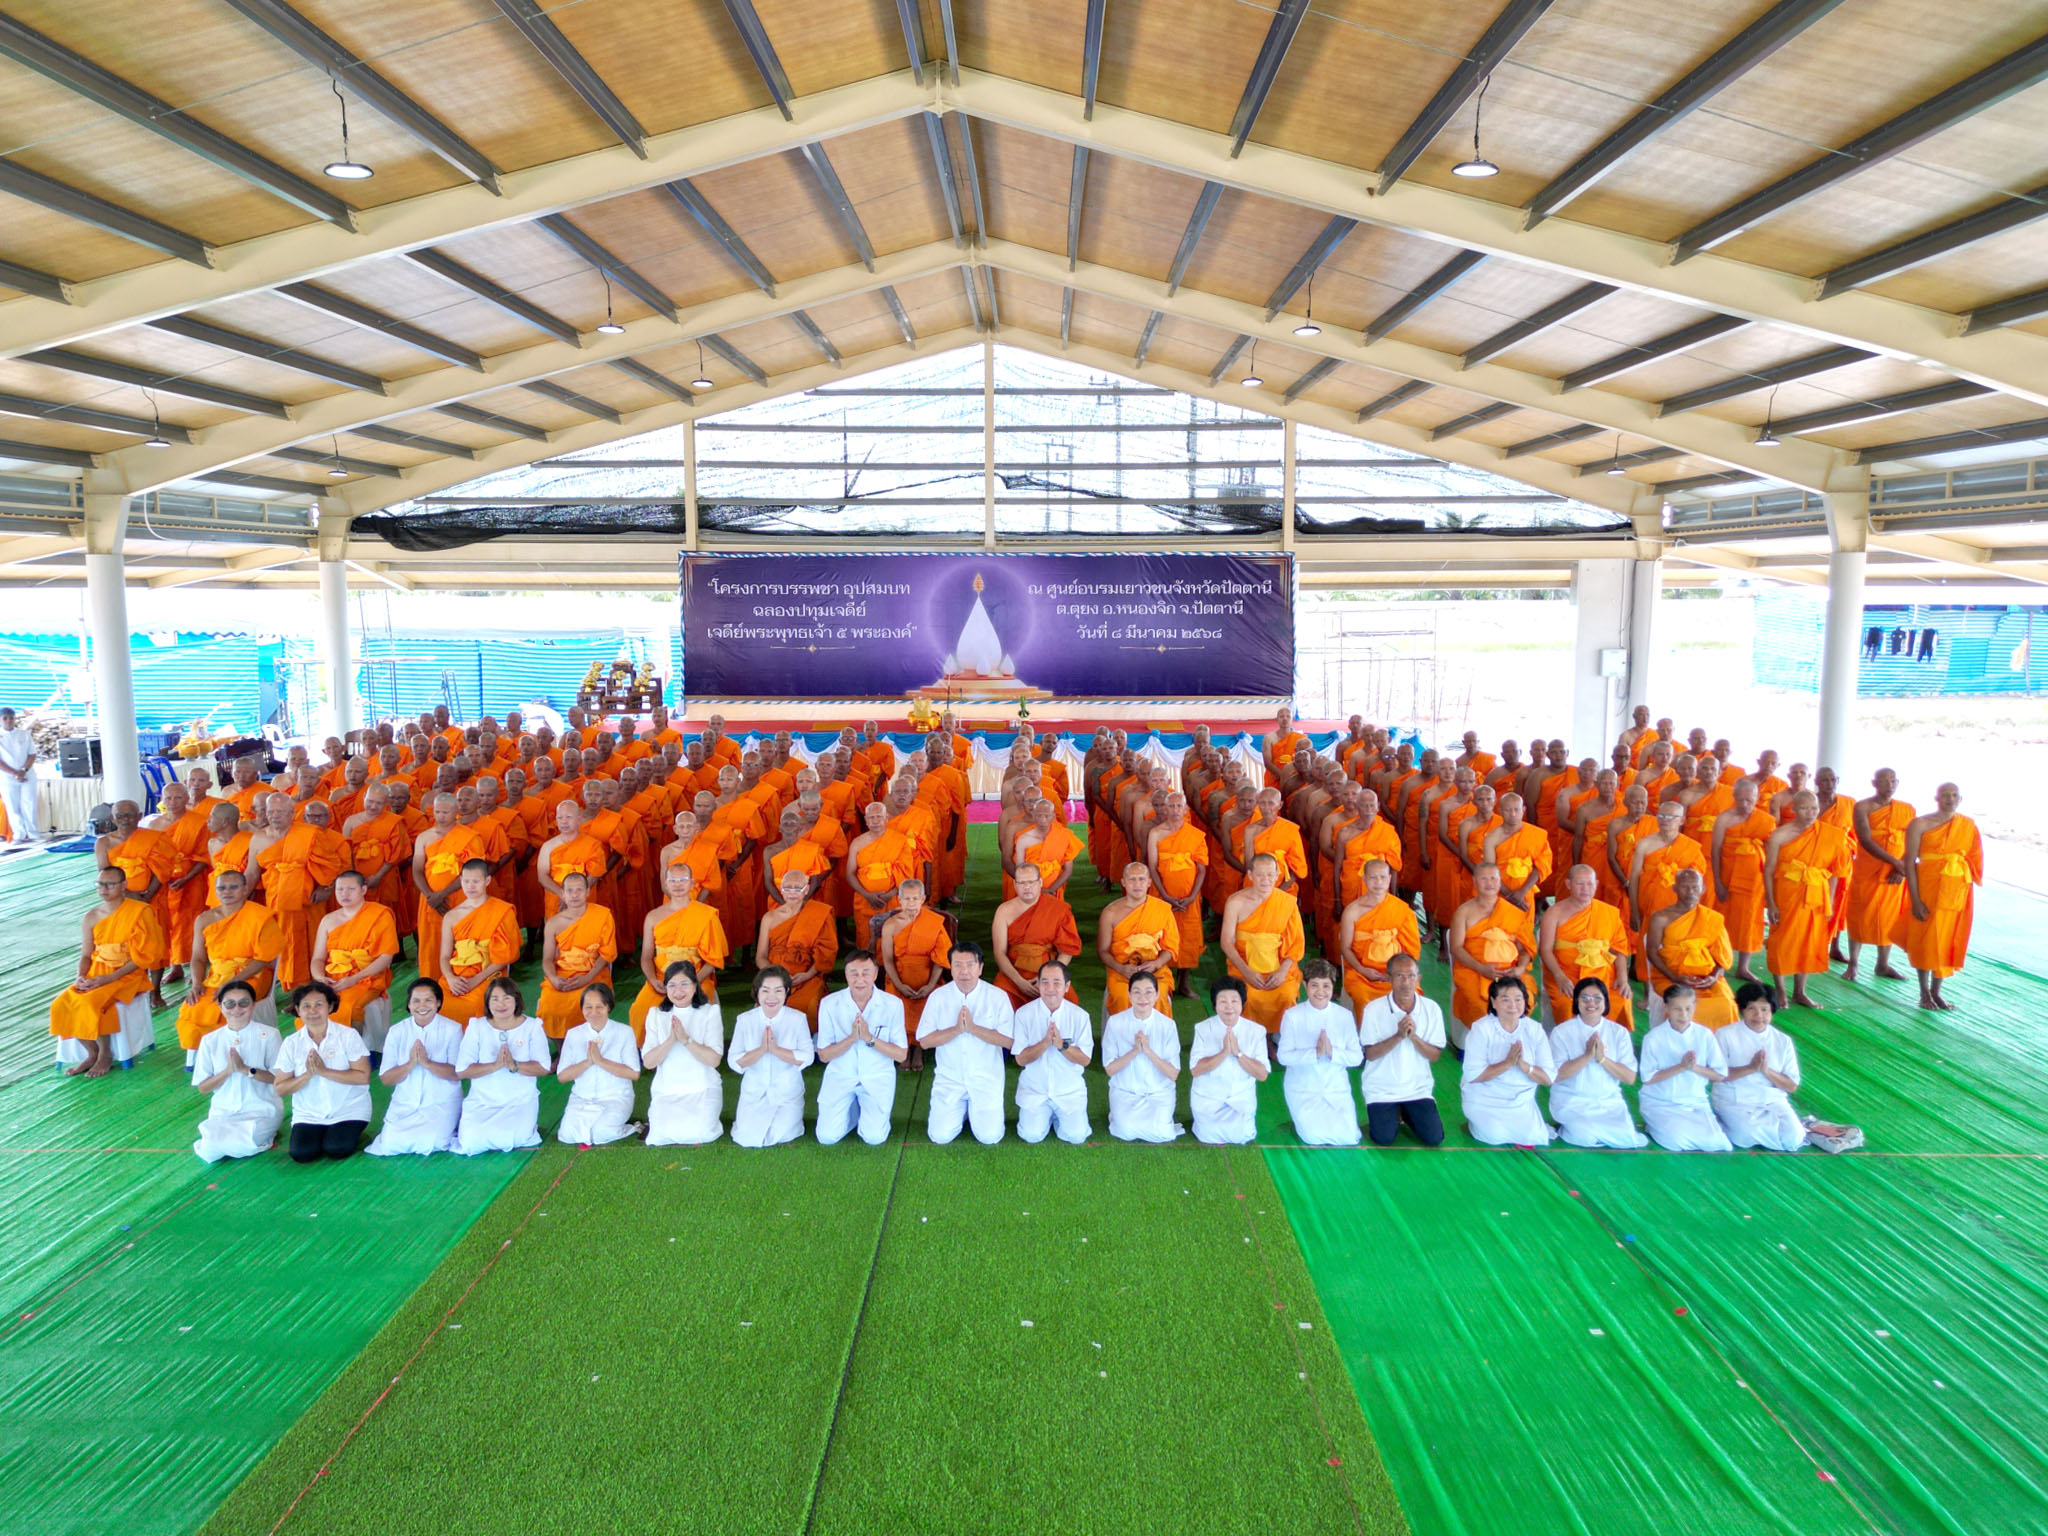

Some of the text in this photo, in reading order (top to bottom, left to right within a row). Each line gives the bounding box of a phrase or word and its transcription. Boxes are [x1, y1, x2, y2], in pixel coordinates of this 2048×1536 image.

[843, 581, 910, 599] อุปสมบท
[1028, 578, 1272, 599] ณ ศูนย์อบรมเยาวชนจังหวัดปัตตานี
[752, 600, 866, 621] ฉลองปทุมเจดีย์
[1056, 600, 1244, 619] ต.ตุยง อ.หนองจิก จ.ปัตตานี
[707, 623, 833, 643] เจดีย์พระพุทธเจ้า
[837, 628, 847, 639] ๕
[1077, 621, 1108, 639] วันที่
[1125, 624, 1177, 639] มีนาคม
[1181, 628, 1223, 639] ๒๕๖๘
